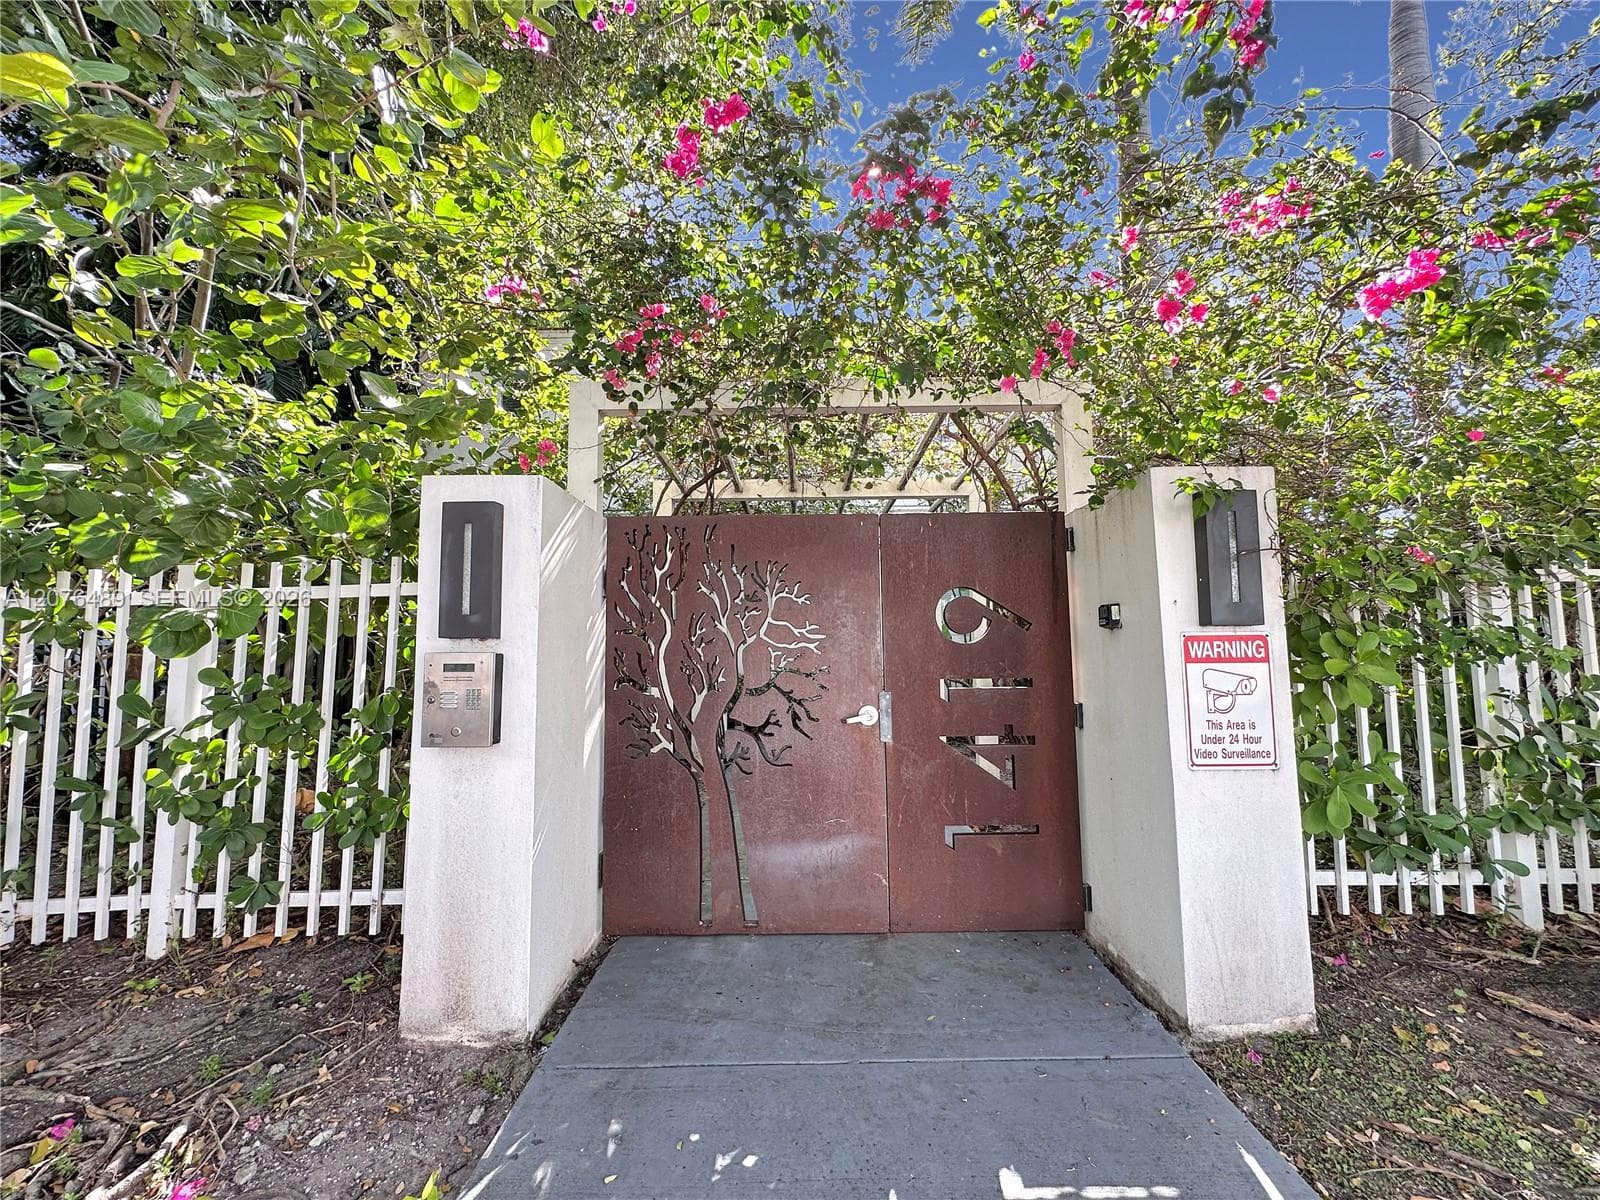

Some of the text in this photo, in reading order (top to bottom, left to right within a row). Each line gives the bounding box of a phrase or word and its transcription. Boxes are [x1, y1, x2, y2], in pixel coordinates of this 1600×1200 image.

[1187, 640, 1265, 658] WARNING
[935, 586, 1040, 850] 1419
[1206, 720, 1256, 730] This Area is
[1201, 734, 1262, 745] Under 24 Hour
[1194, 748, 1271, 759] Video Surveillance
